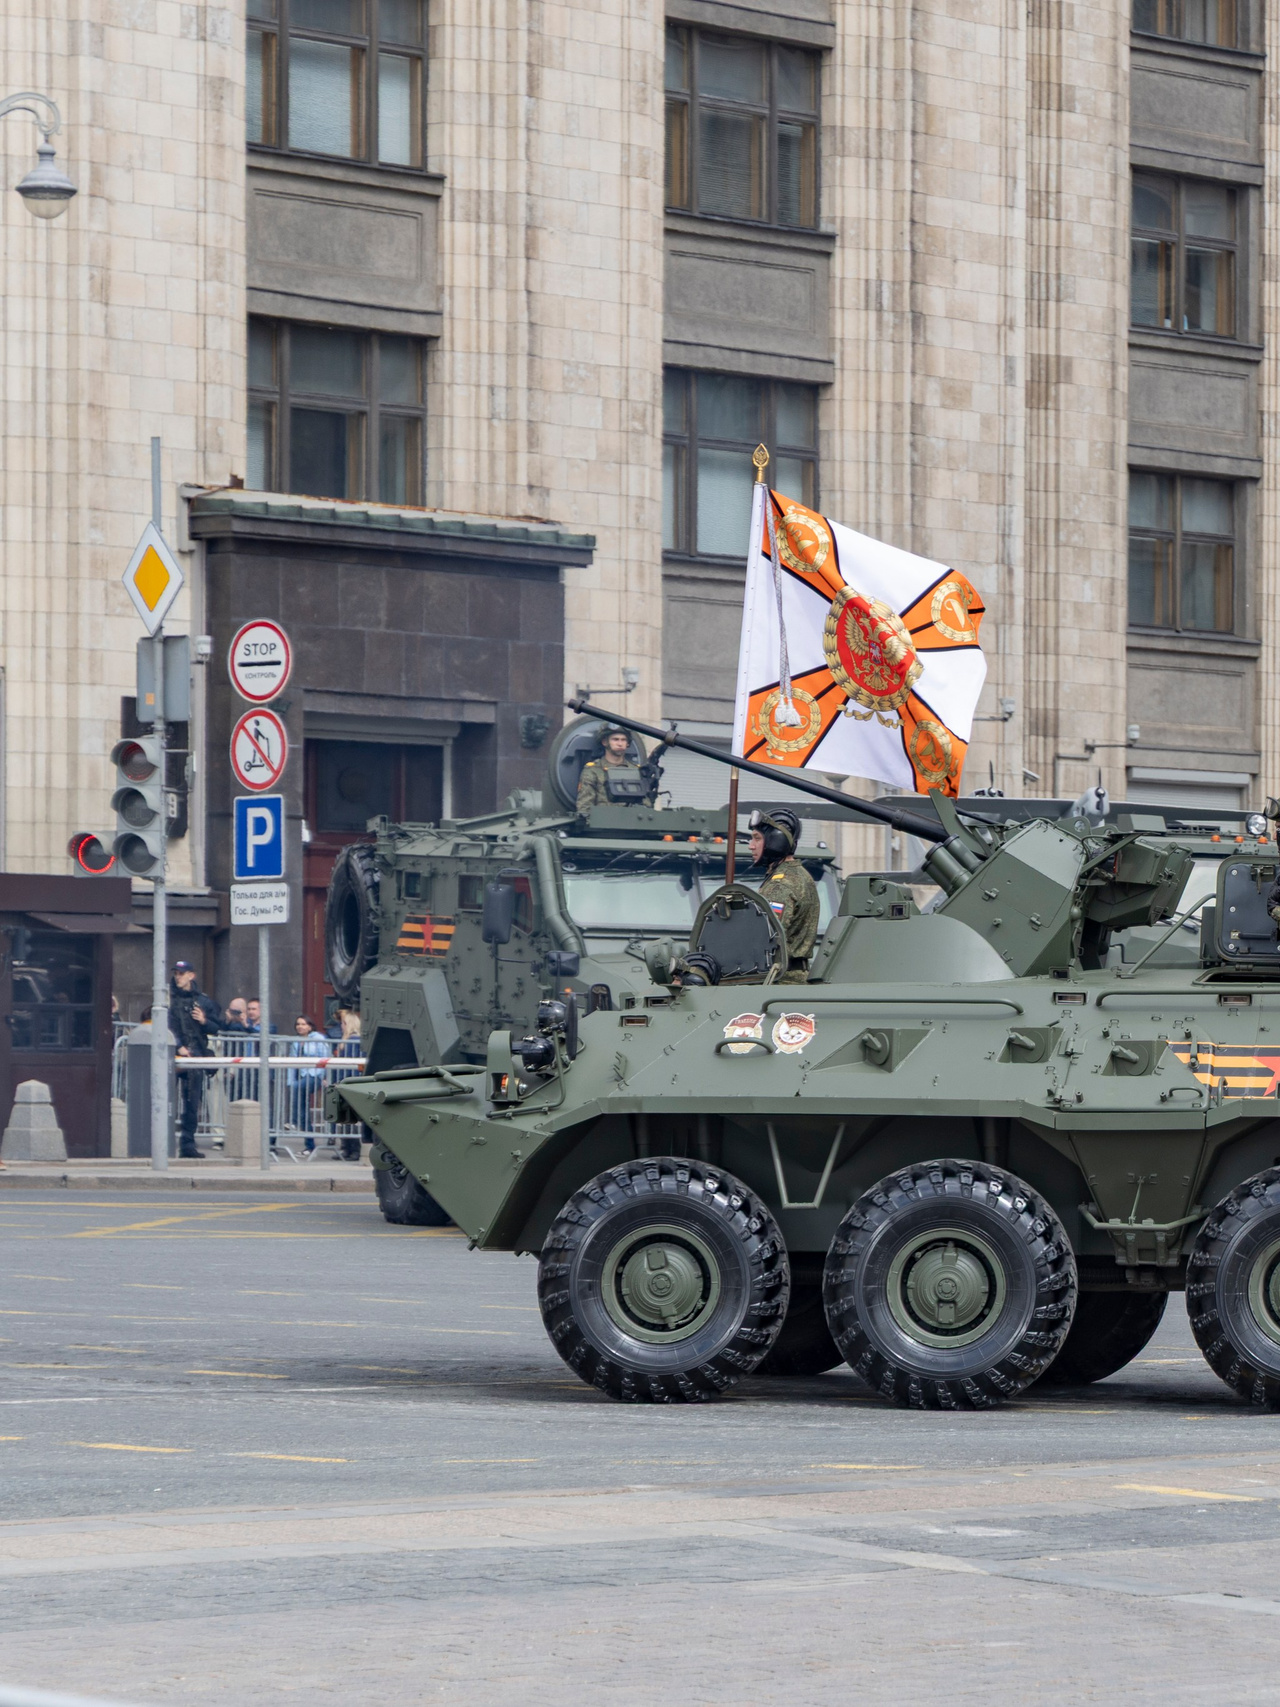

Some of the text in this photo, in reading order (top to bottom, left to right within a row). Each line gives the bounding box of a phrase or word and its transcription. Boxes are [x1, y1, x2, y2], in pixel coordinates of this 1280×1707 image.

[243, 642, 277, 657] STOP
[246, 807, 274, 868] P
[232, 890, 258, 900] Только
[259, 891, 273, 900] для
[234, 904, 284, 917] Гос. Думы РФ
